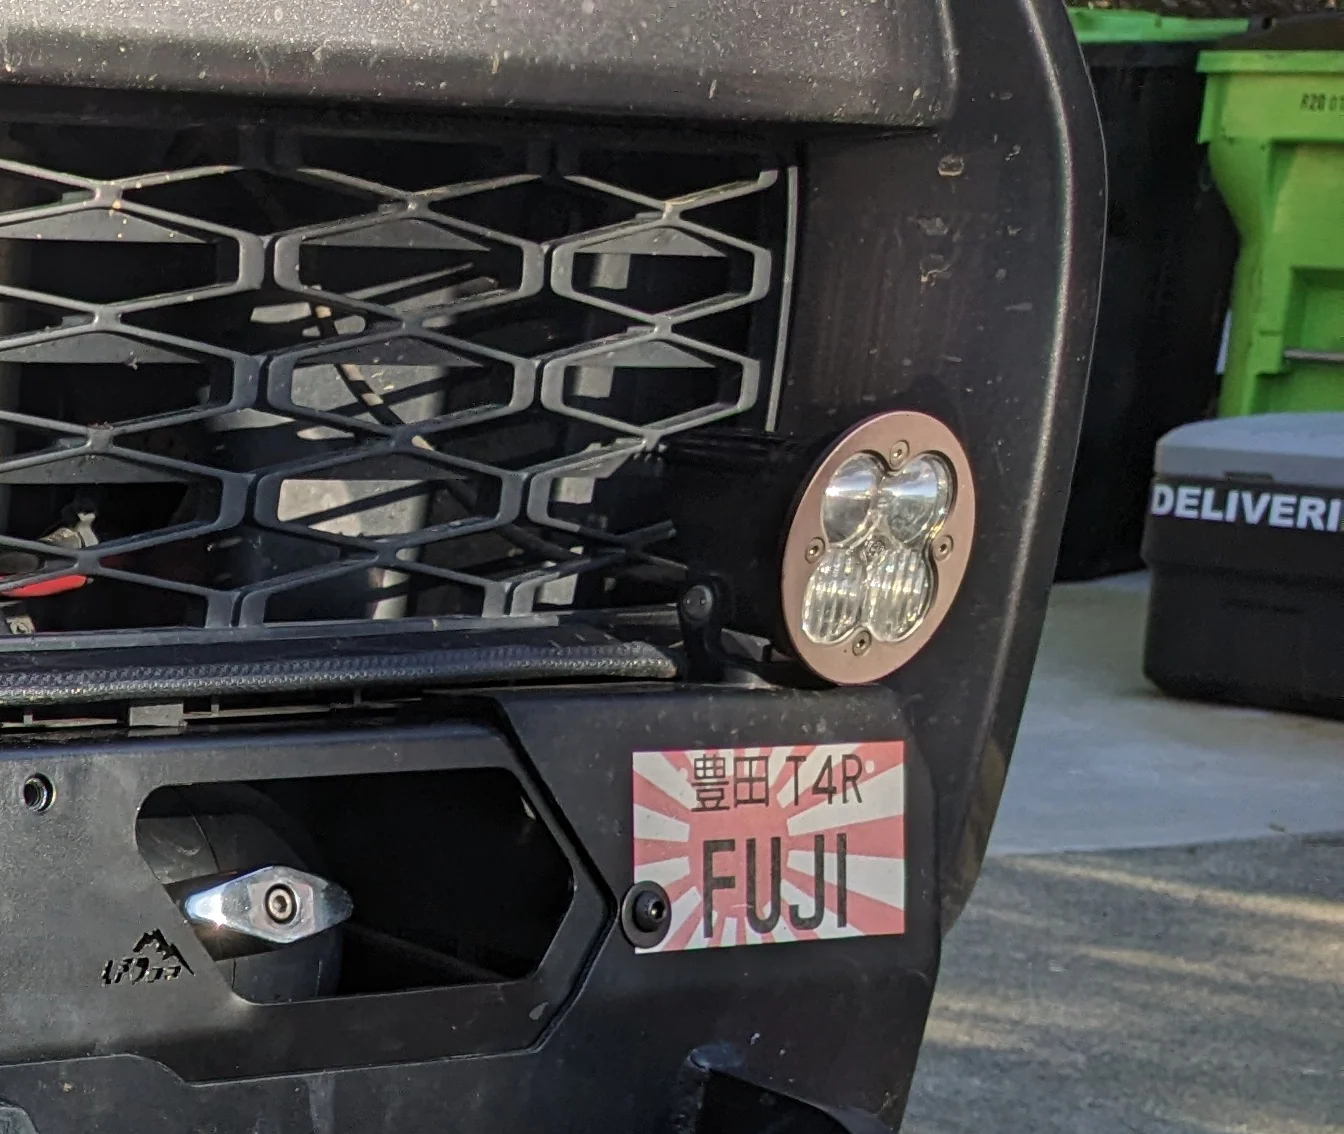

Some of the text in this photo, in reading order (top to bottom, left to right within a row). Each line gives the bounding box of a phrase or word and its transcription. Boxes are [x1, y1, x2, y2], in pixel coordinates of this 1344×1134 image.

[1150, 483, 1341, 532] DELIVERI
[691, 753, 863, 812] 豊田 T4R
[703, 833, 847, 938] FUJI
